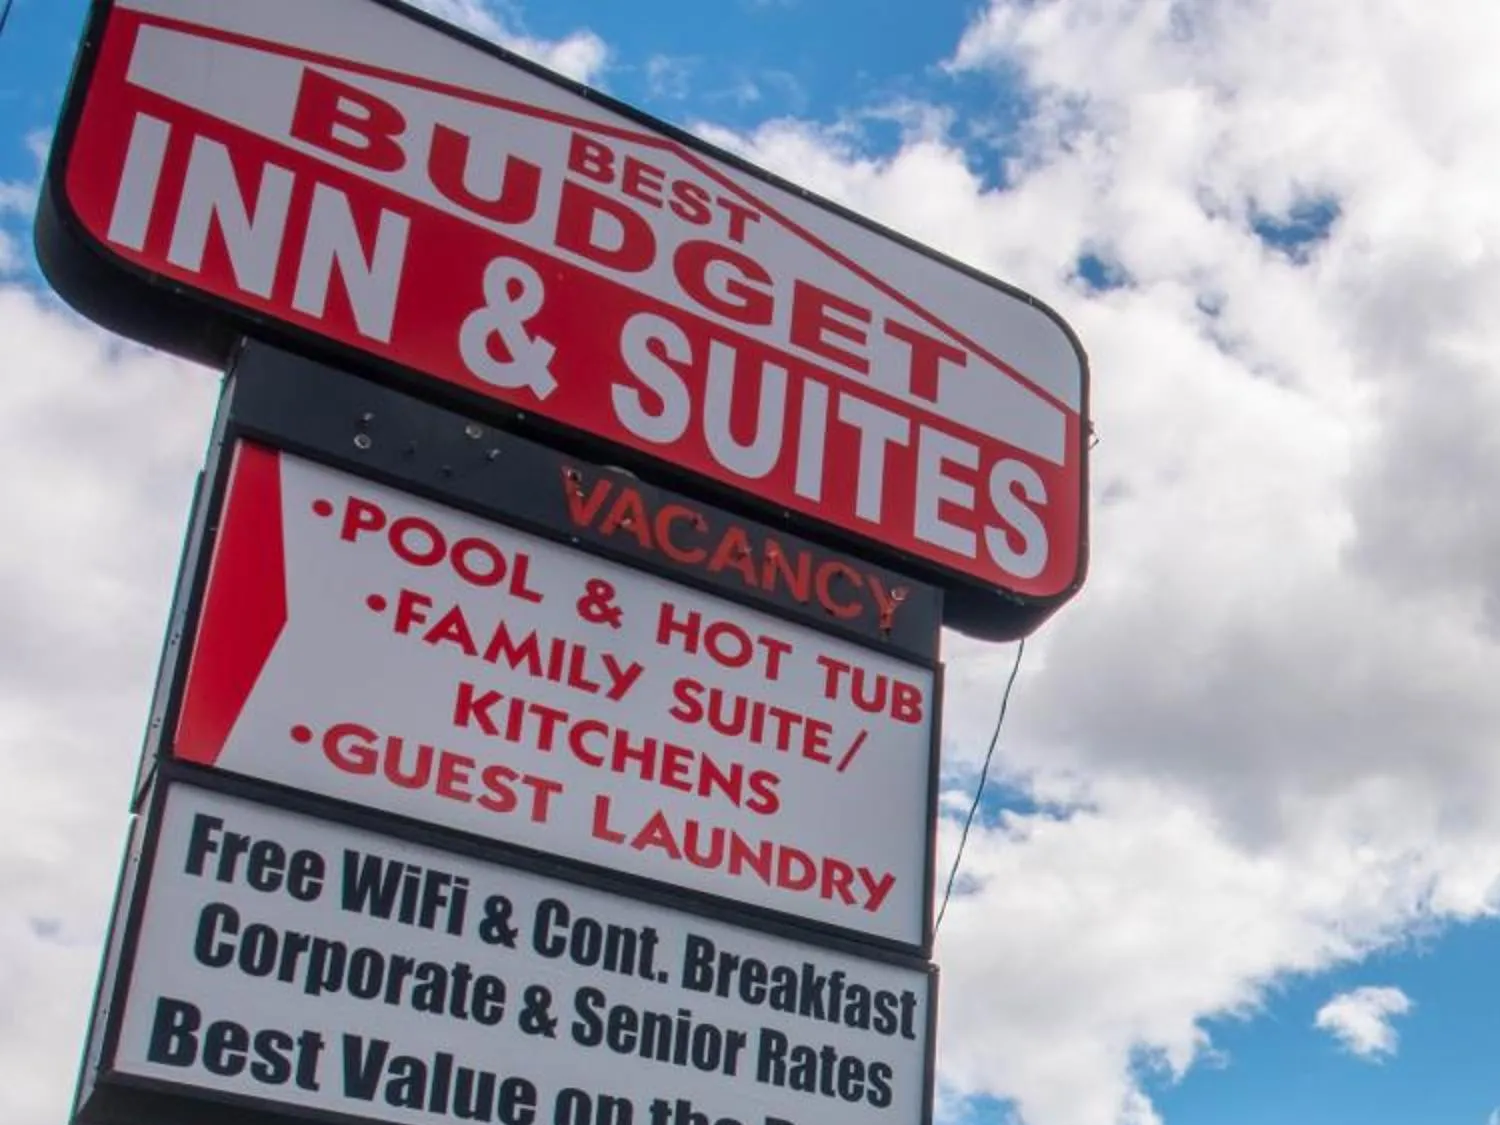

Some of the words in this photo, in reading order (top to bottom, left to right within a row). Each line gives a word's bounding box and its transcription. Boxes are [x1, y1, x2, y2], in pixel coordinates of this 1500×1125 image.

[291, 67, 967, 402] BUDGET
[568, 132, 762, 243] BEST
[109, 113, 410, 343] INN
[459, 257, 557, 401] &
[612, 313, 1050, 580] SUITES
[340, 496, 544, 603] POOL
[577, 579, 623, 628] &
[657, 603, 793, 681] HOT
[817, 655, 923, 725] TUB
[561, 466, 913, 638] VACANCY
[393, 590, 645, 702] FAMILY
[670, 678, 868, 773] SUITE/
[453, 680, 781, 815] KITCHENS
[321, 722, 563, 823] GUEST
[591, 794, 896, 913] LAUNDRY
[184, 812, 326, 903] Free
[341, 849, 470, 937] WiFi
[478, 894, 520, 950] &
[533, 897, 670, 985] Cont.
[681, 932, 918, 1041] Breakfast
[194, 902, 506, 1027] Corporate
[518, 984, 559, 1040] &
[571, 985, 748, 1077] Senior
[756, 1026, 894, 1109] Rates
[147, 996, 326, 1093] Best
